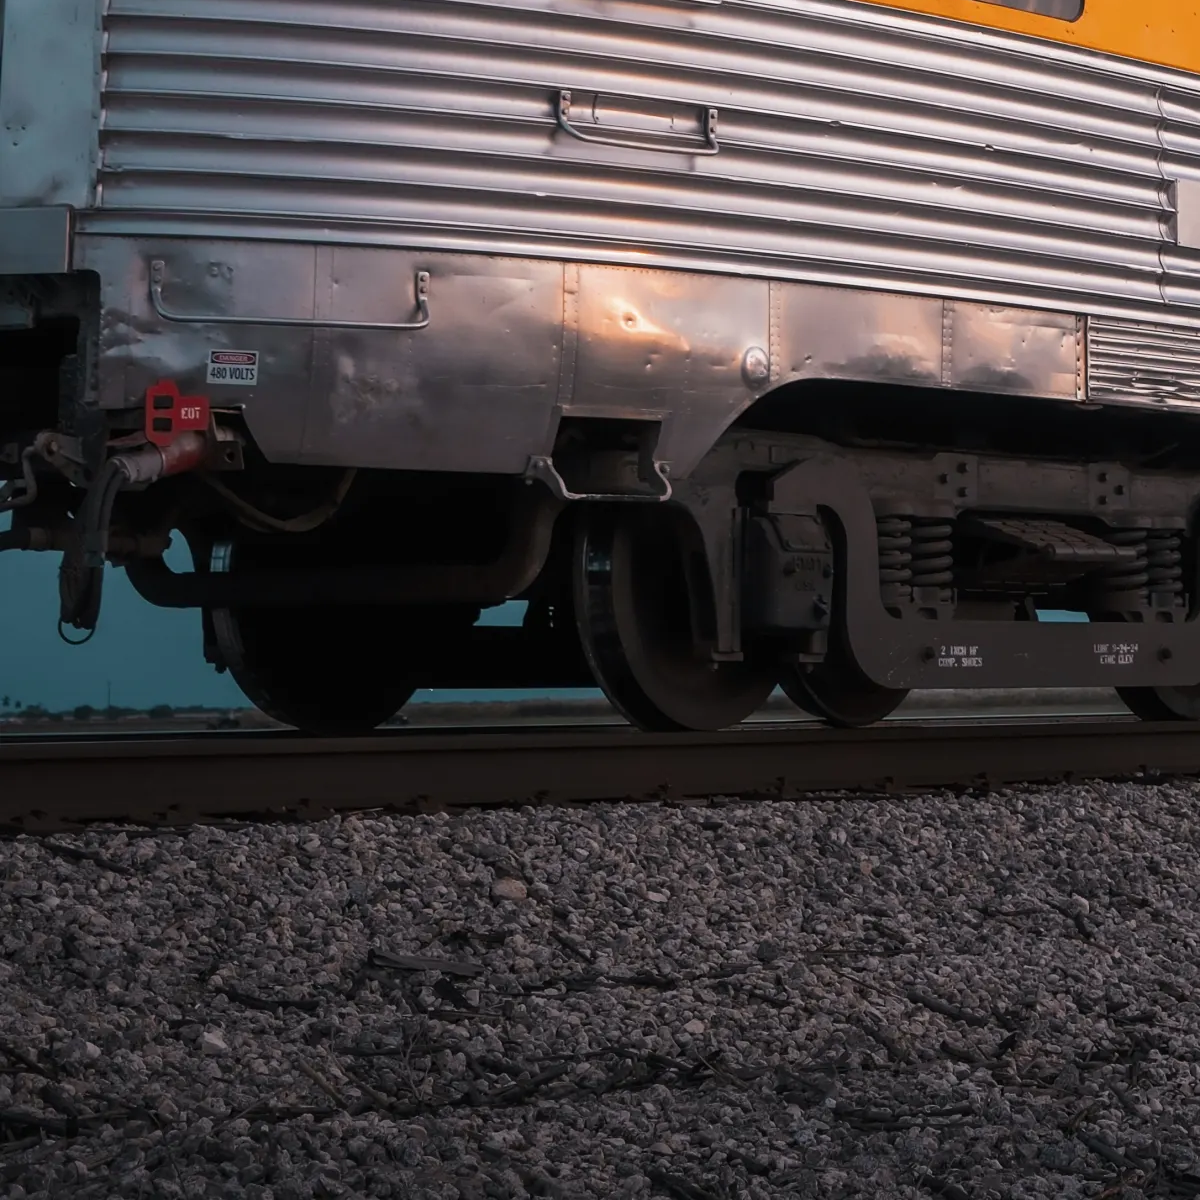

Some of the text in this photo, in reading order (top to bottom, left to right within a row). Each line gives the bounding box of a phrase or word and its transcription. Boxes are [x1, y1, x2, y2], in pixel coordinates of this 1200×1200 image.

[219, 354, 248, 362] DANGER
[210, 367, 255, 380] 480 VOLTS
[181, 407, 201, 419] EOT
[940, 645, 946, 655] 2
[961, 657, 983, 667] SHOES
